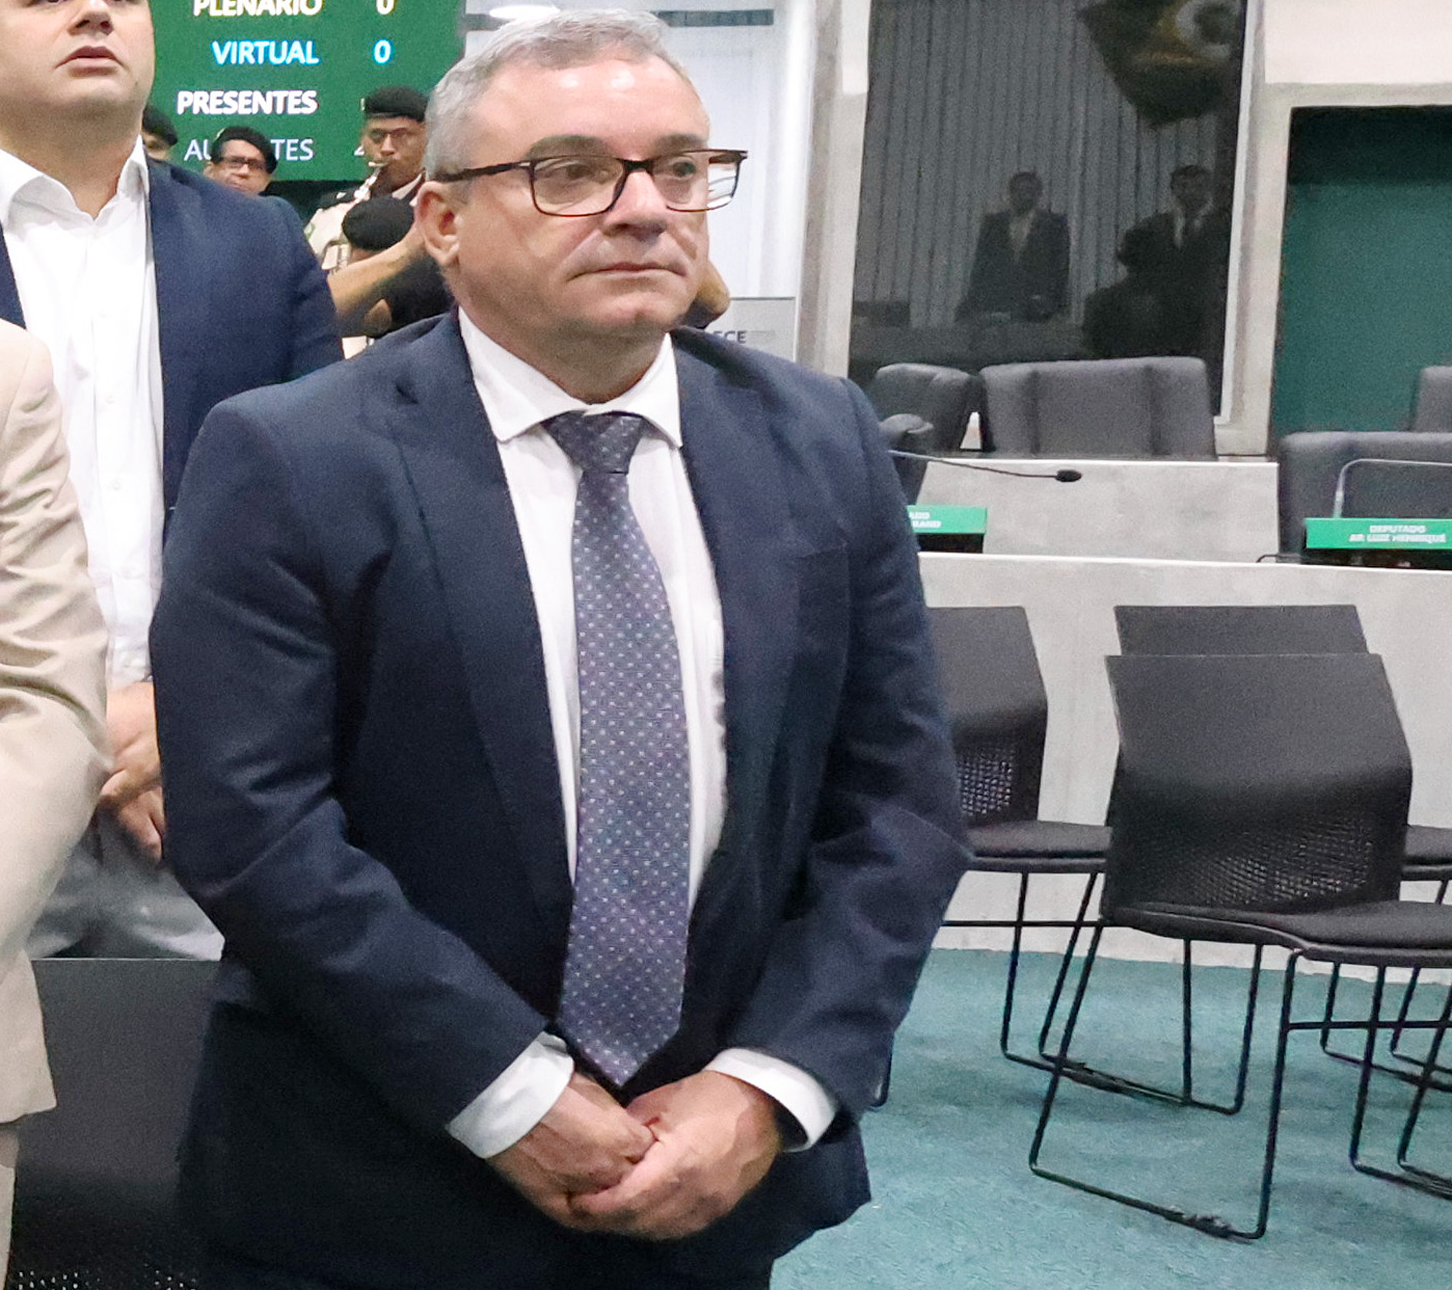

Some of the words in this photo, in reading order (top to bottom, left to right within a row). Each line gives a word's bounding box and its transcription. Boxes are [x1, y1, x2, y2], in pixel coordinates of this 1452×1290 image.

[213, 41, 319, 64] VIRTUAL
[375, 41, 390, 62] 0
[177, 90, 318, 115] PRESENTES
[184, 139, 314, 161] AUTES
